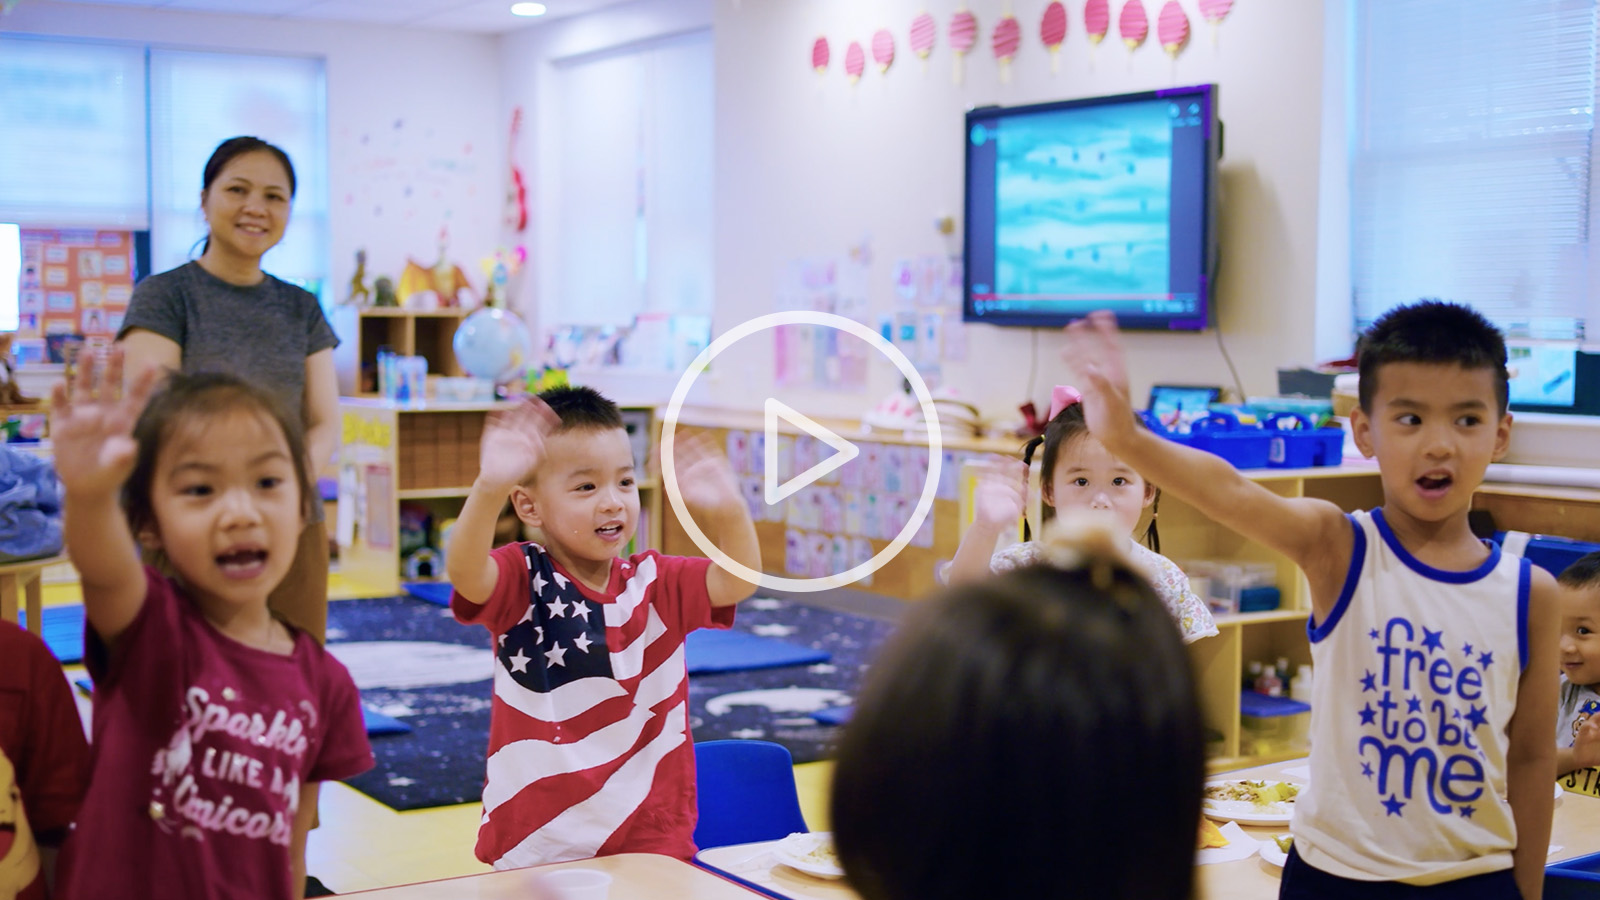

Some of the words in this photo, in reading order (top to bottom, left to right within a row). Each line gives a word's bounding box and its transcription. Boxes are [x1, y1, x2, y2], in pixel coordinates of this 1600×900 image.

[1377, 617, 1483, 701] free
[186, 686, 308, 757] Sparkle
[1377, 690, 1426, 744] to
[202, 747, 264, 788] LIKE
[1359, 736, 1485, 815] me
